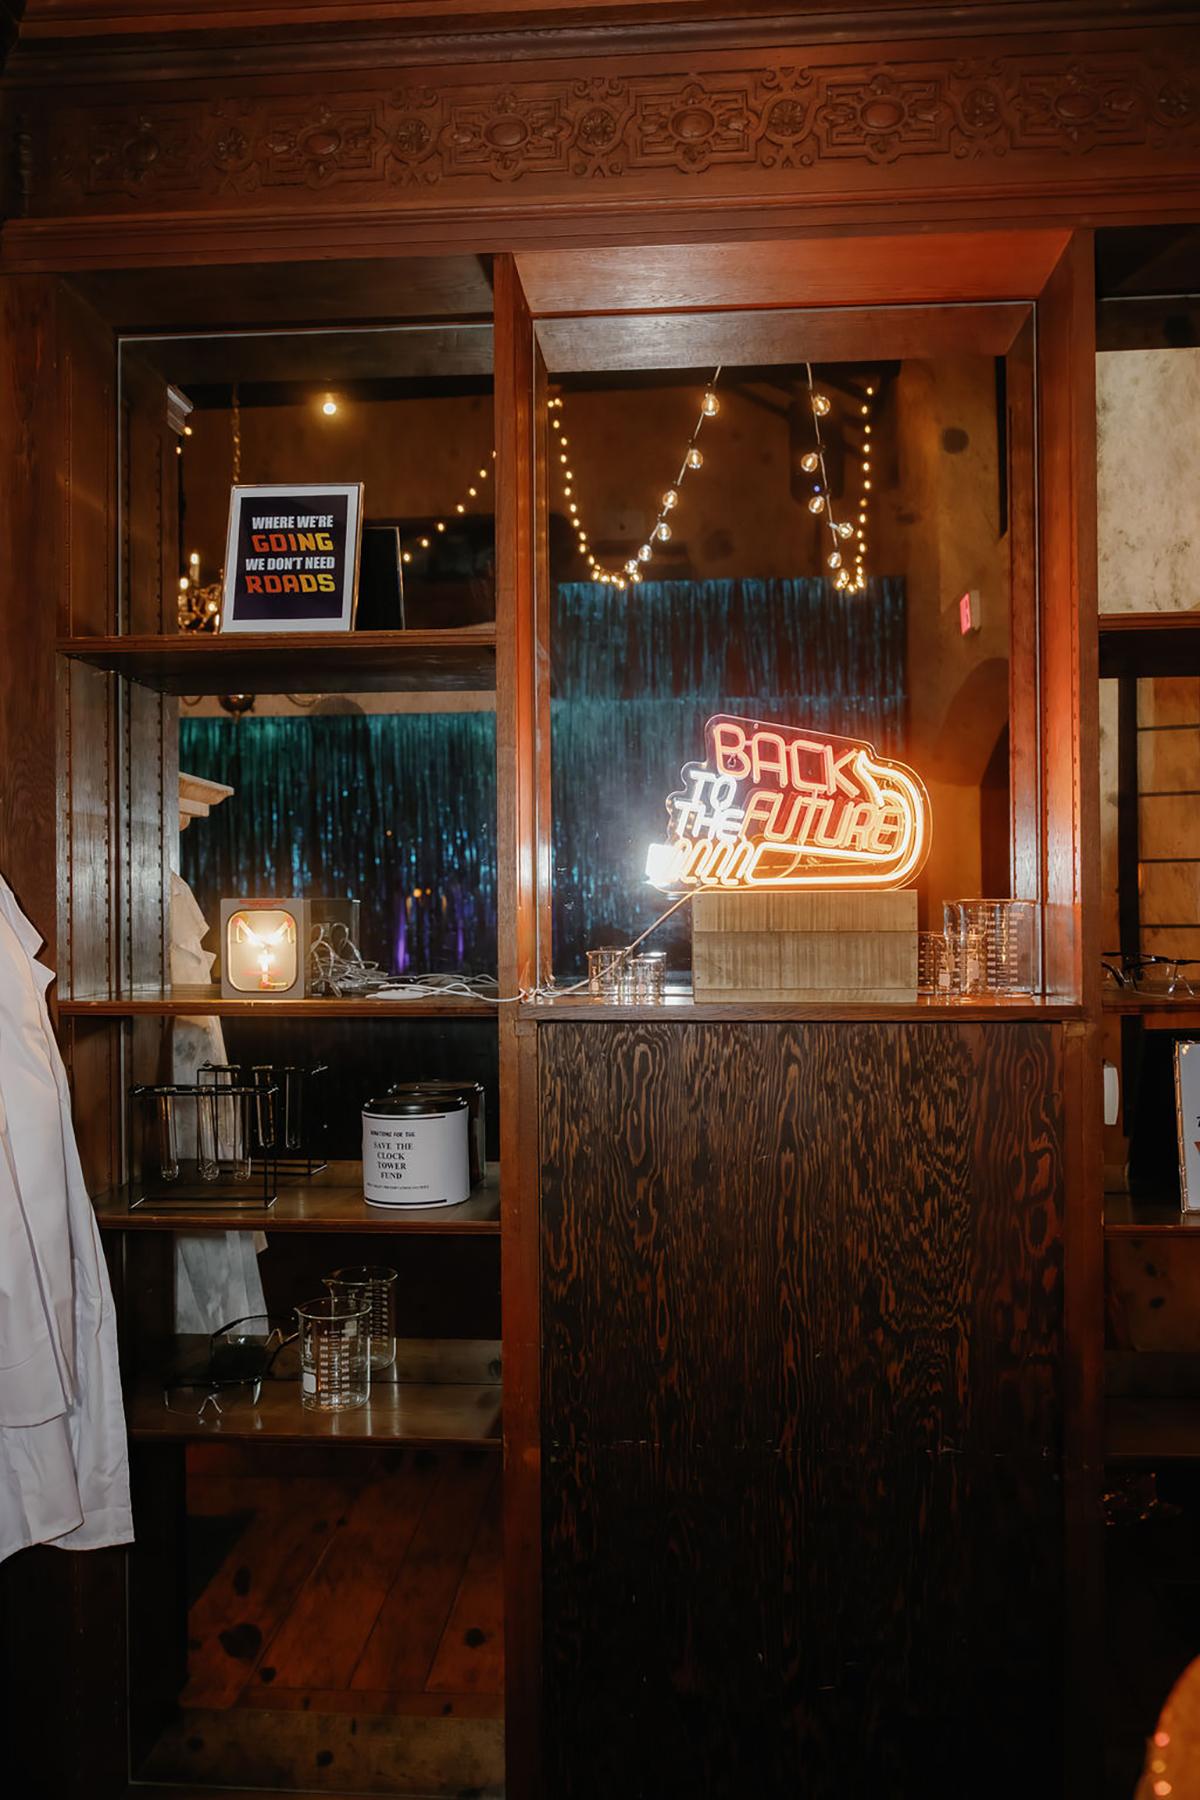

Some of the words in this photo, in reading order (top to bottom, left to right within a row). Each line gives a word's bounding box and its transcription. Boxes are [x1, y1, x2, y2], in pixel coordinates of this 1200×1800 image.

[252, 516, 294, 529] WHERE
[297, 515, 334, 528] WE'RE
[251, 532, 334, 553] GOING
[245, 558, 265, 571] WE
[267, 557, 303, 570] DON'T
[305, 556, 335, 569] NEED
[245, 573, 336, 593] ROADS
[713, 723, 862, 798] BACK
[689, 769, 737, 811] TO
[674, 800, 745, 844] THE
[739, 790, 905, 852] FUTURE
[374, 1142, 392, 1150] SAVE
[396, 1142, 414, 1151] THE
[377, 1152, 405, 1160] CLOCK
[377, 1161, 407, 1170] TOWER
[381, 1171, 402, 1180] FUND
